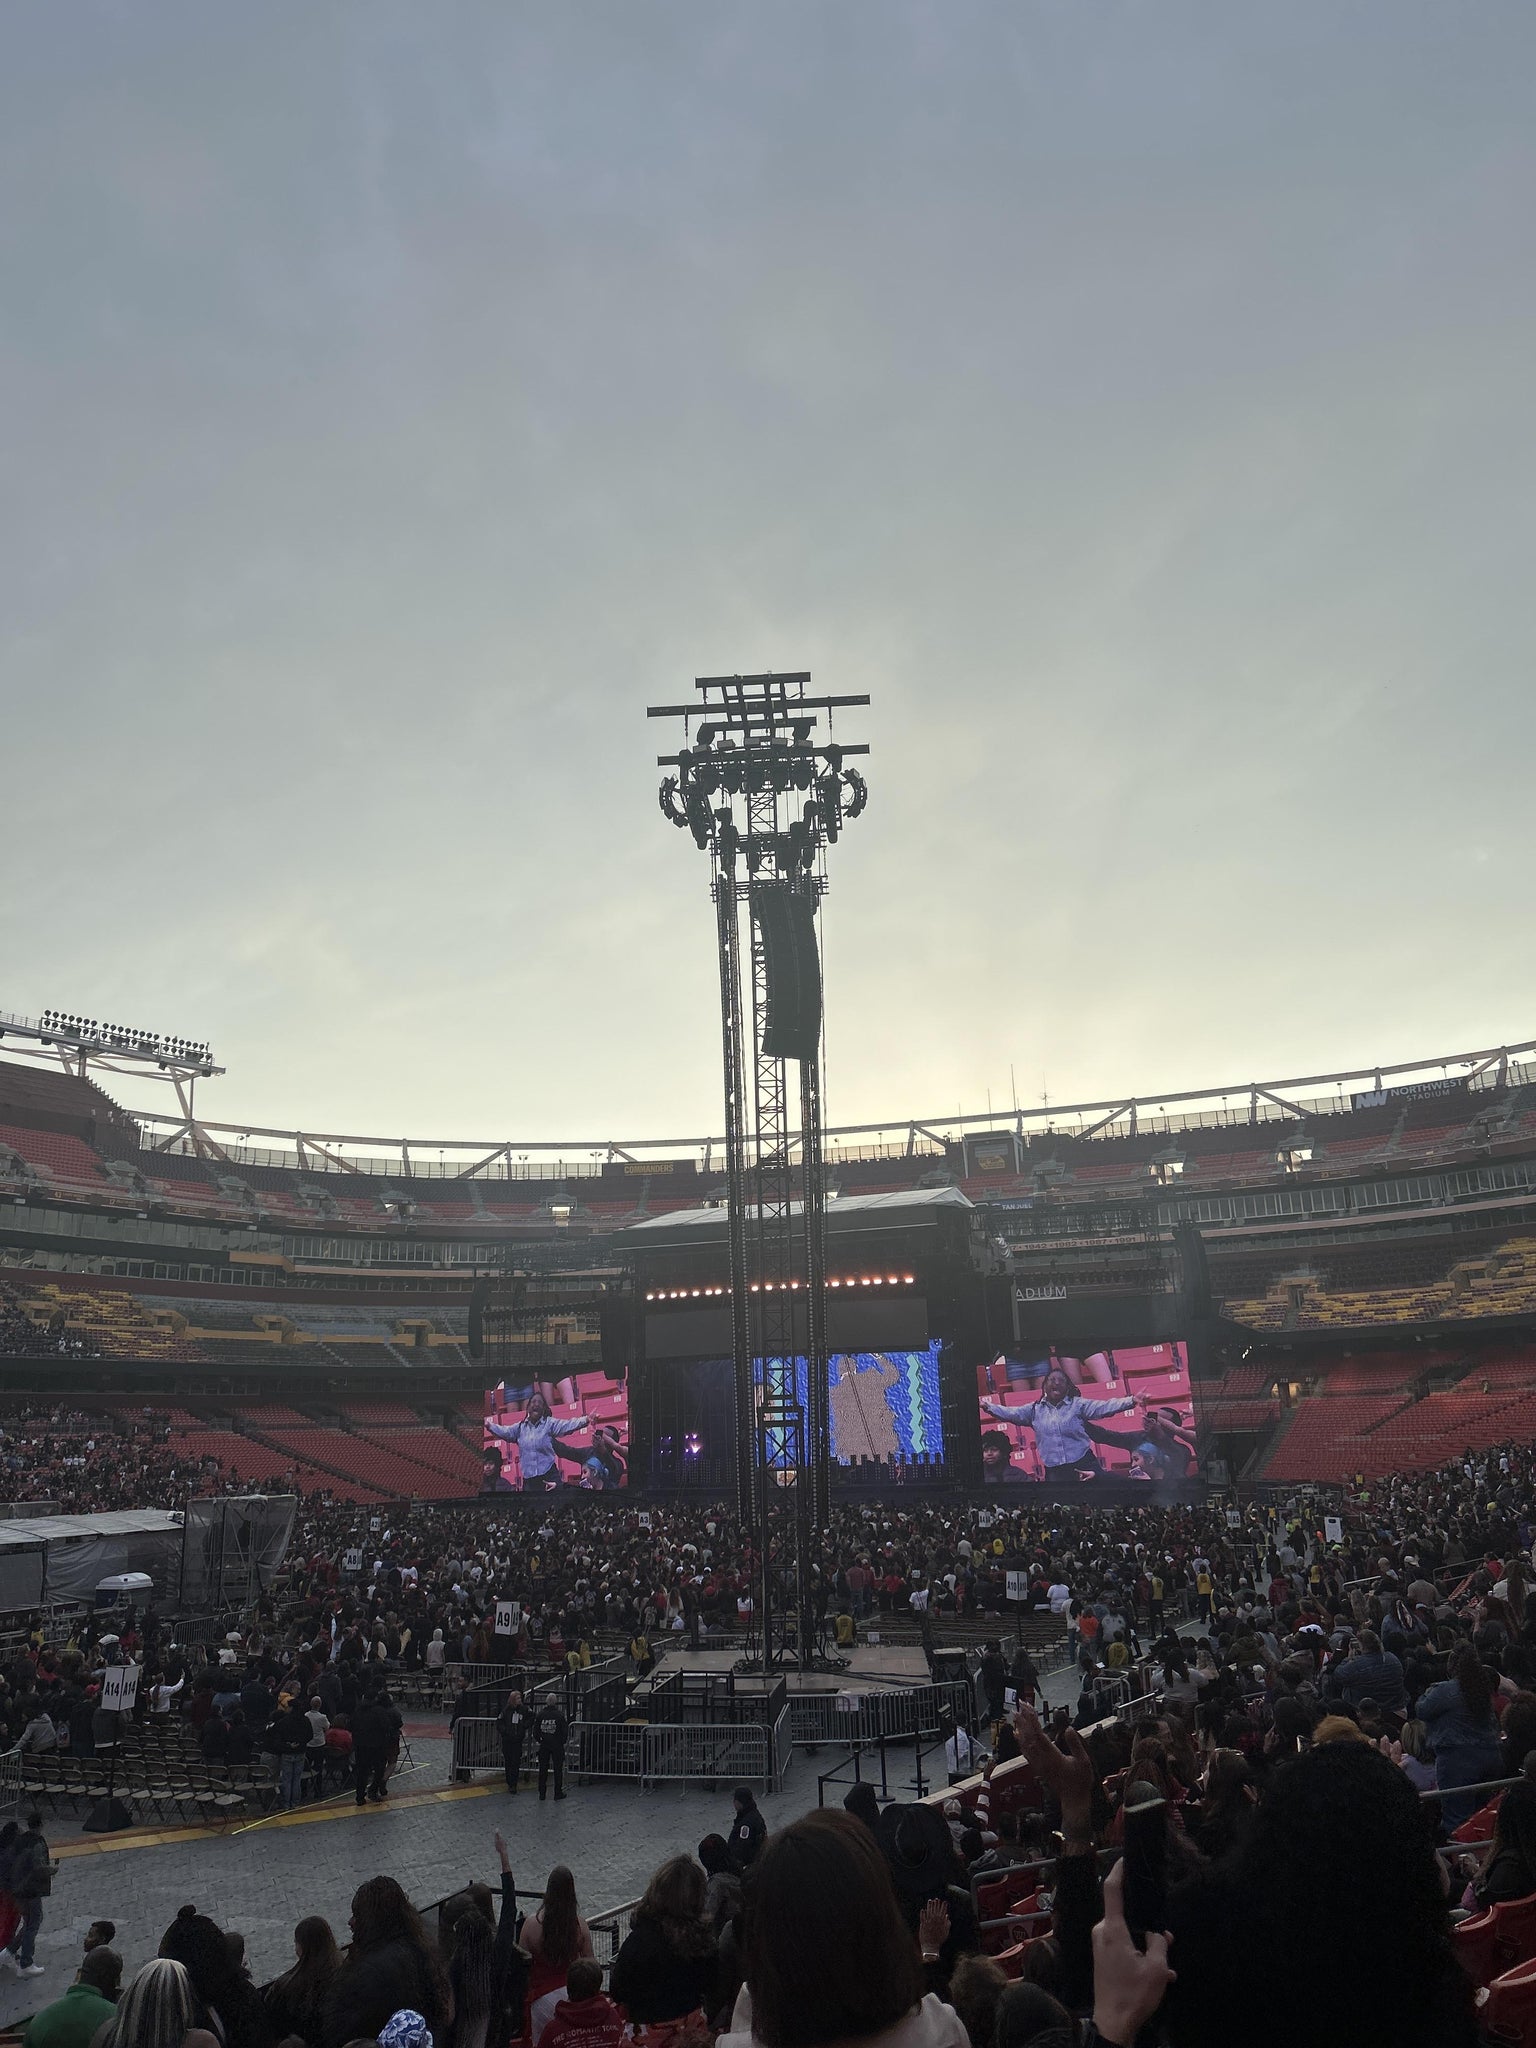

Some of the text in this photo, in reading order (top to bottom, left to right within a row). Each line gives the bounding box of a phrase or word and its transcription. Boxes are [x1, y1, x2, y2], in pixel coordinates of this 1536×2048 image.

[1390, 1078, 1463, 1097] NORTHWEST
[1356, 1090, 1388, 1109] NW
[1407, 1089, 1450, 1102] STADIUM
[624, 1164, 674, 1174] COMMANDERS
[1016, 1285, 1068, 1299] ADIUM
[640, 1516, 649, 1524] A3
[1233, 1515, 1240, 1524] A5
[347, 1555, 357, 1565] A8
[1007, 1581, 1017, 1592] A10
[497, 1611, 510, 1627] A9
[104, 1681, 120, 1696] A14
[122, 1680, 136, 1696] A14
[551, 2033, 565, 2046] THE
